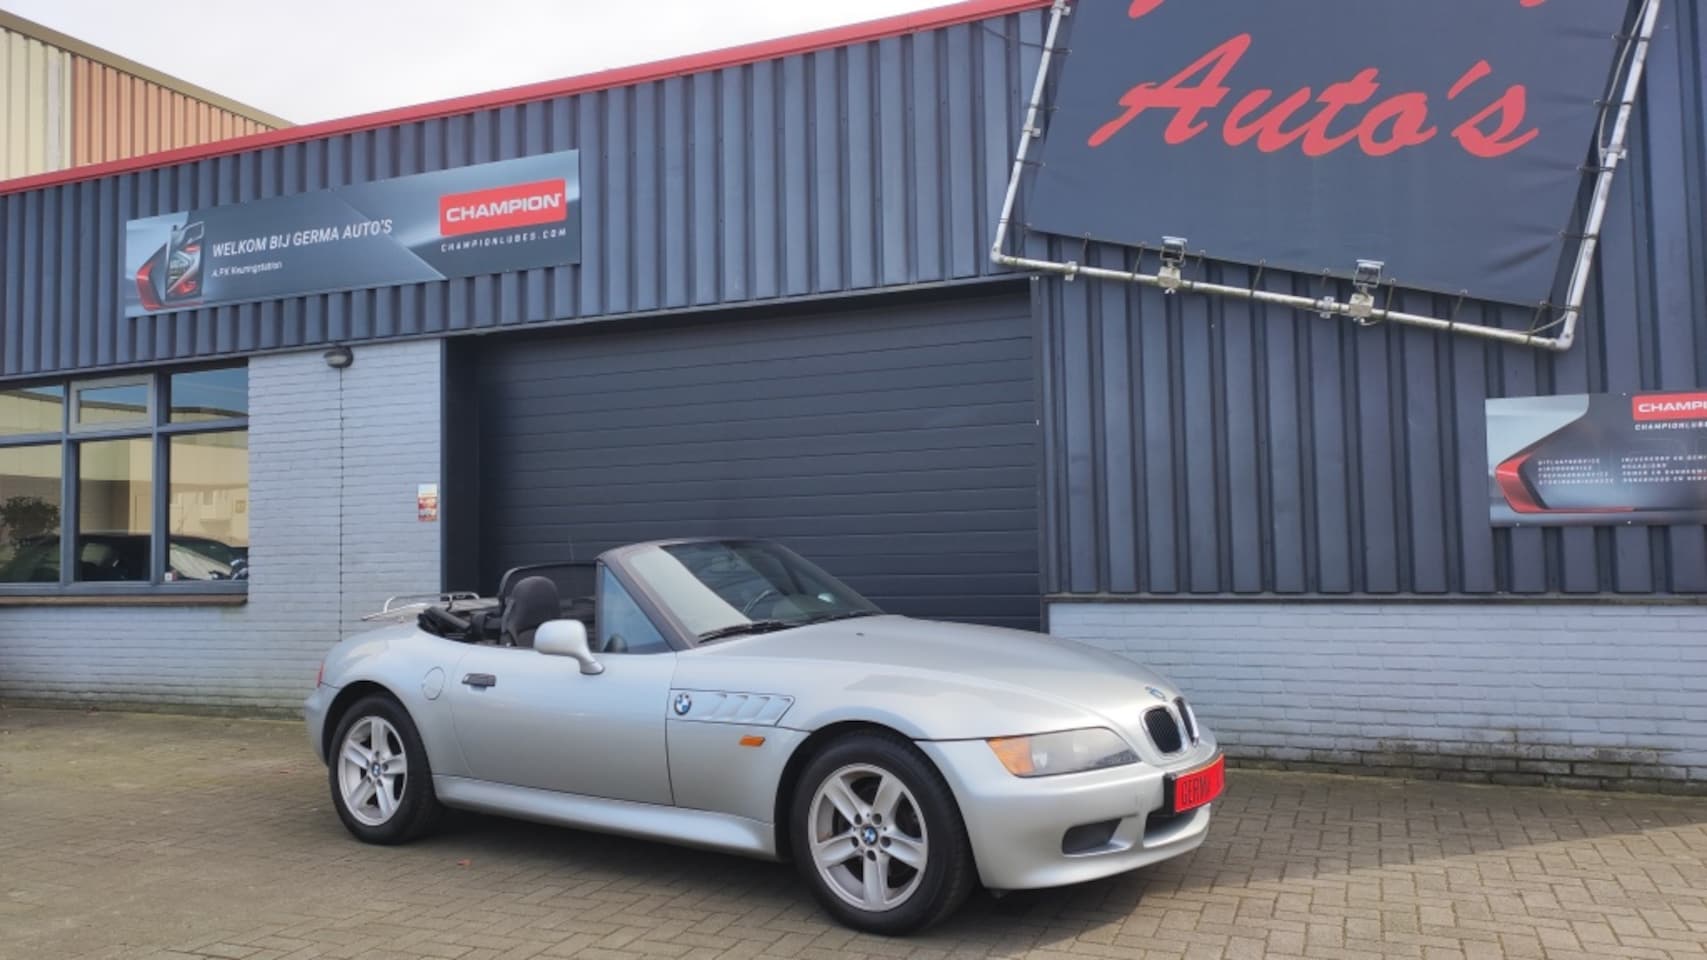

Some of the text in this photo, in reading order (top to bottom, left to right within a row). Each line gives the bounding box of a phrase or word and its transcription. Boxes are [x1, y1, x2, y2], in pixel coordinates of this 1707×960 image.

[1088, 33, 1539, 158] Auto's
[446, 193, 560, 222] CHAMPION
[212, 219, 393, 257] WELKOM BIJ GERMA AUTO'S
[441, 228, 566, 252] CHAMPIONLUBES.COM
